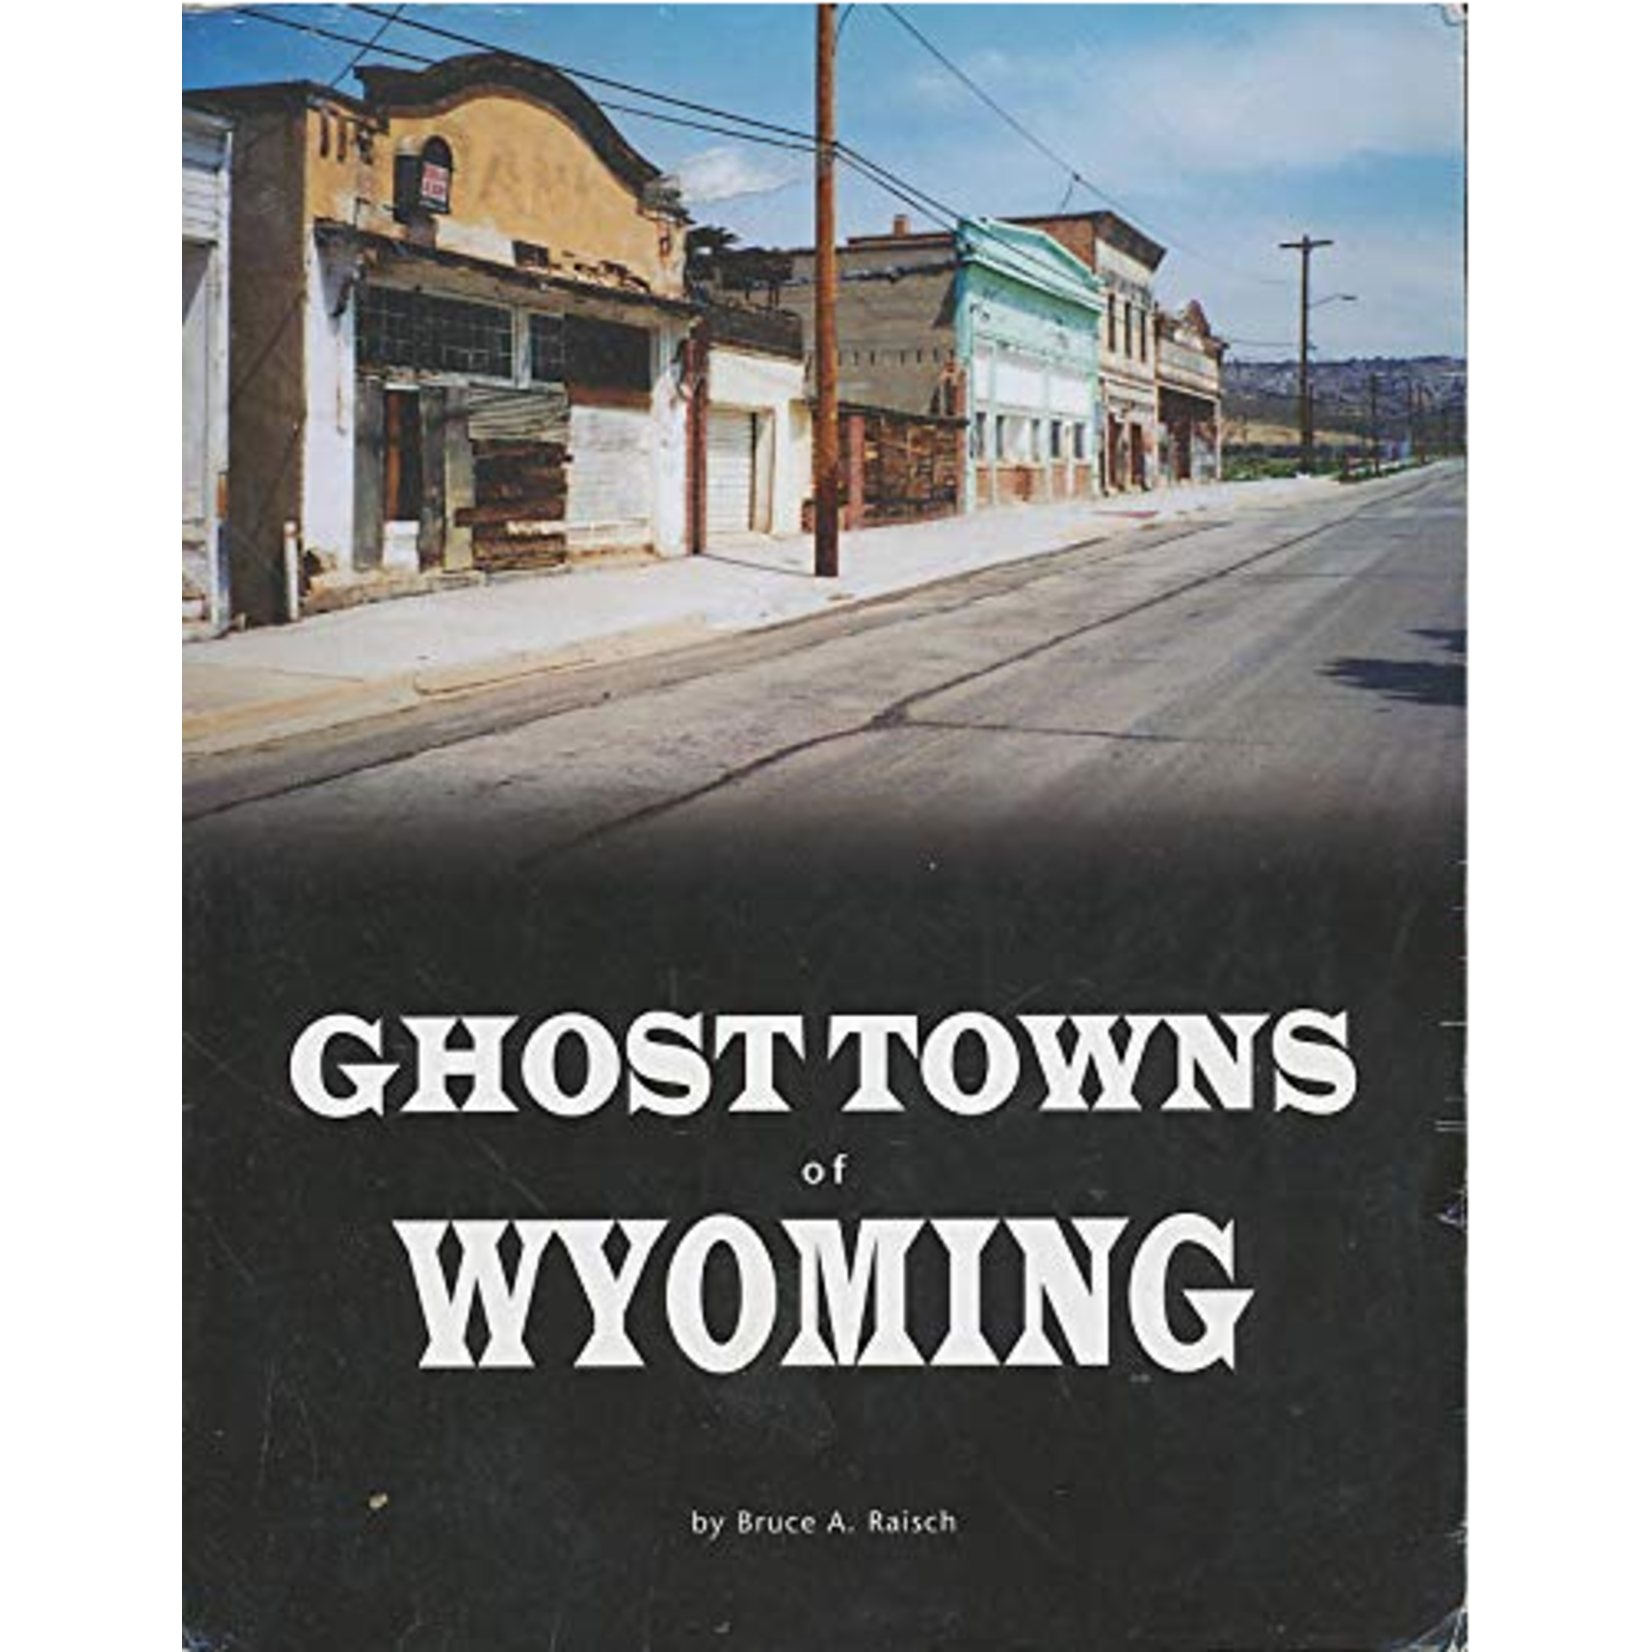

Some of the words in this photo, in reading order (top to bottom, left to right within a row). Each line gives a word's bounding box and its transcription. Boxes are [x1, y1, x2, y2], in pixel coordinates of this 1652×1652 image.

[289, 1011, 806, 1119] GHOST
[827, 1008, 1358, 1117] TOWNS
[801, 1153, 848, 1186] of
[392, 1212, 1256, 1374] WYOMING
[691, 1510, 725, 1540] by
[736, 1509, 817, 1534] Bruce
[826, 1510, 855, 1533] A.
[868, 1509, 957, 1534] Raisch
